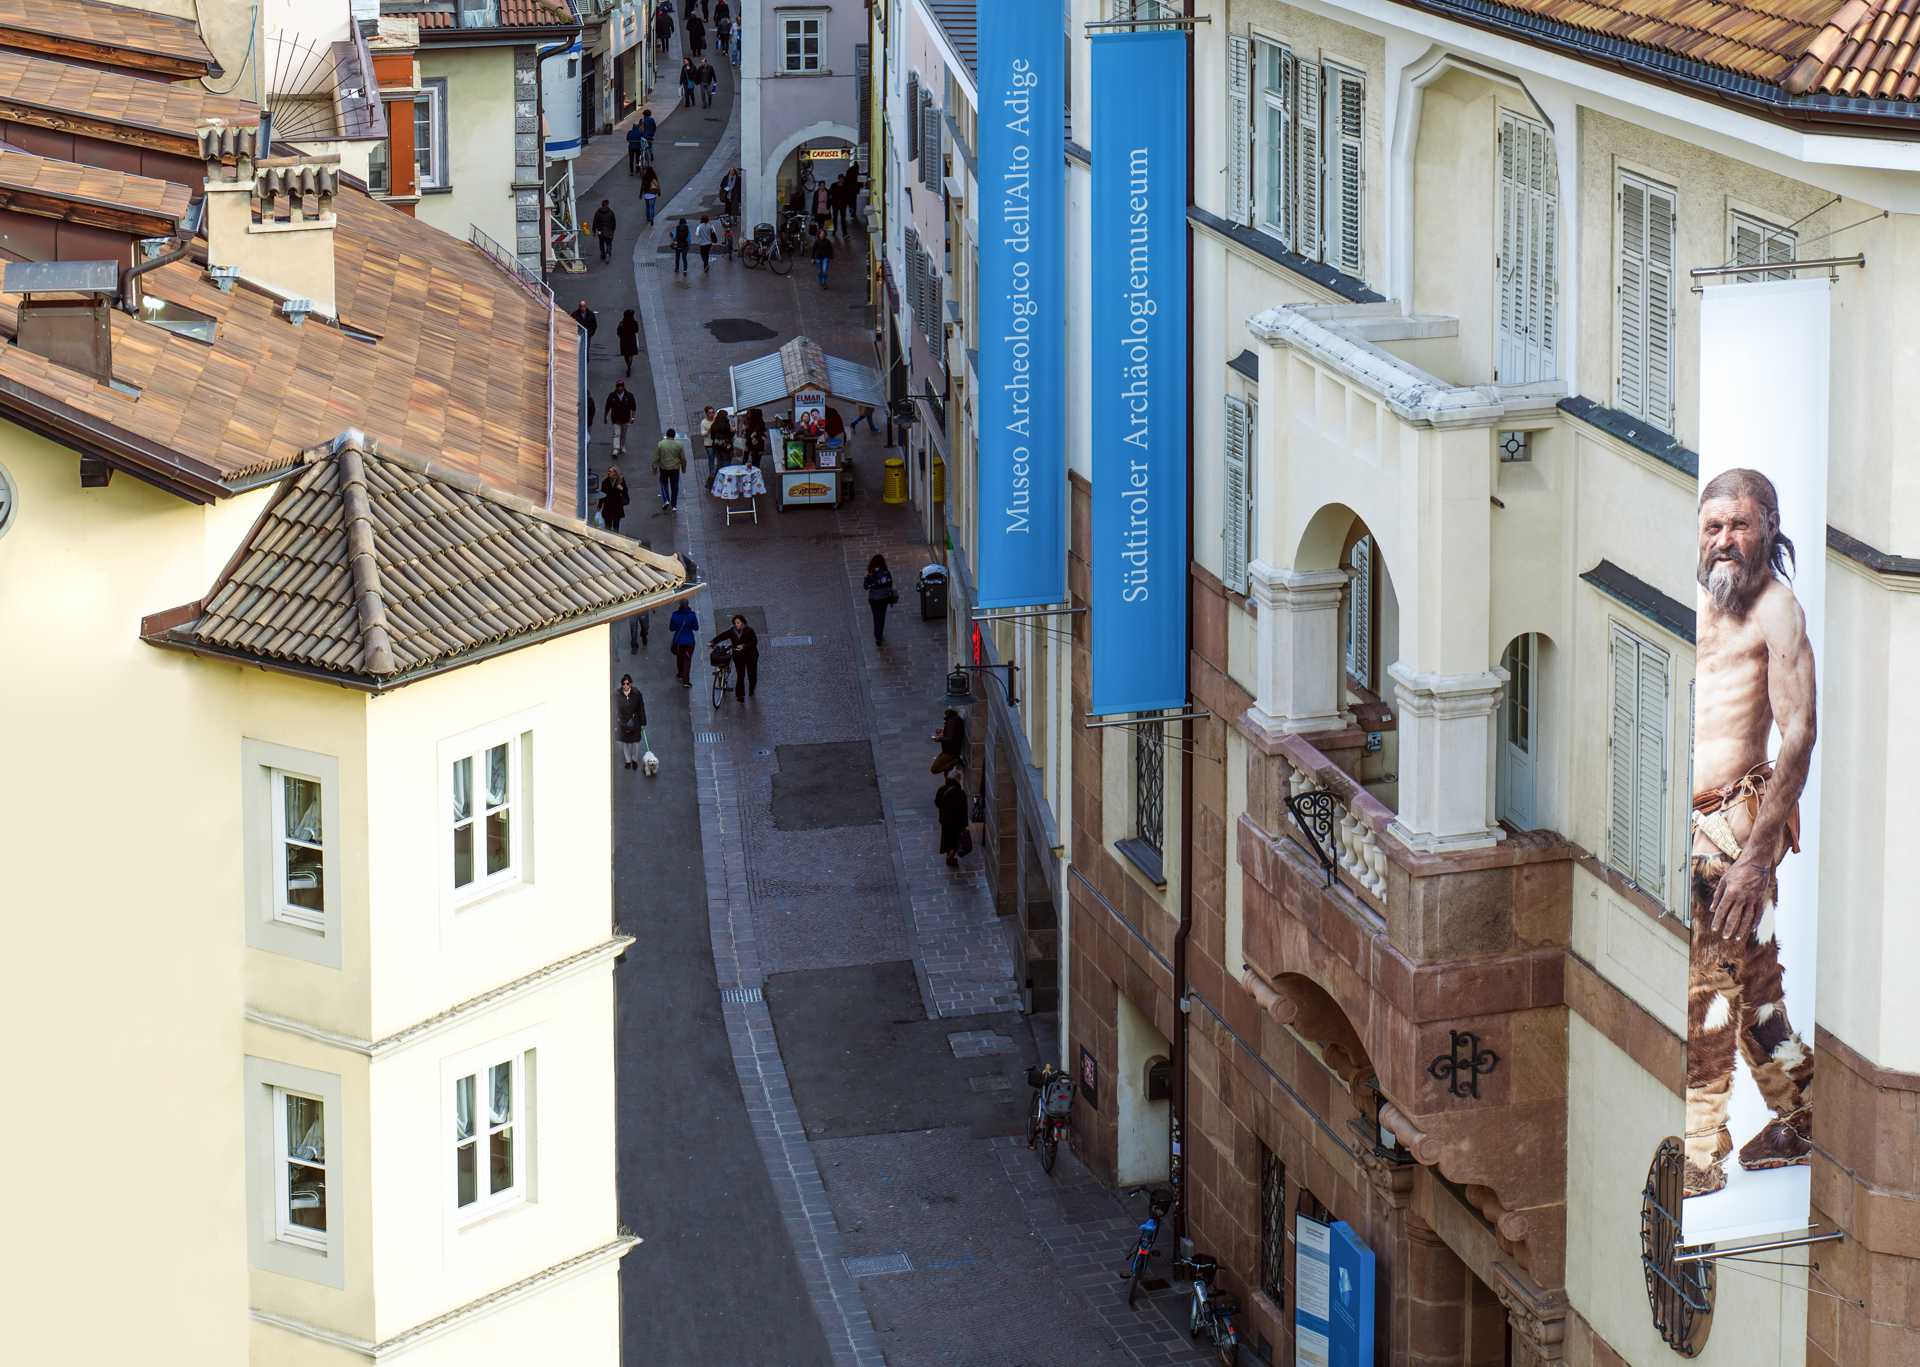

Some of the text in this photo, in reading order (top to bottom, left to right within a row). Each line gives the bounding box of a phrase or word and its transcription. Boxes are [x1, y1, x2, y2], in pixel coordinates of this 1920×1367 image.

[1004, 58, 1038, 534] Museo Archeologico dell'Alto Adige
[1121, 147, 1157, 603] Südtiroler Archäologiemuseum
